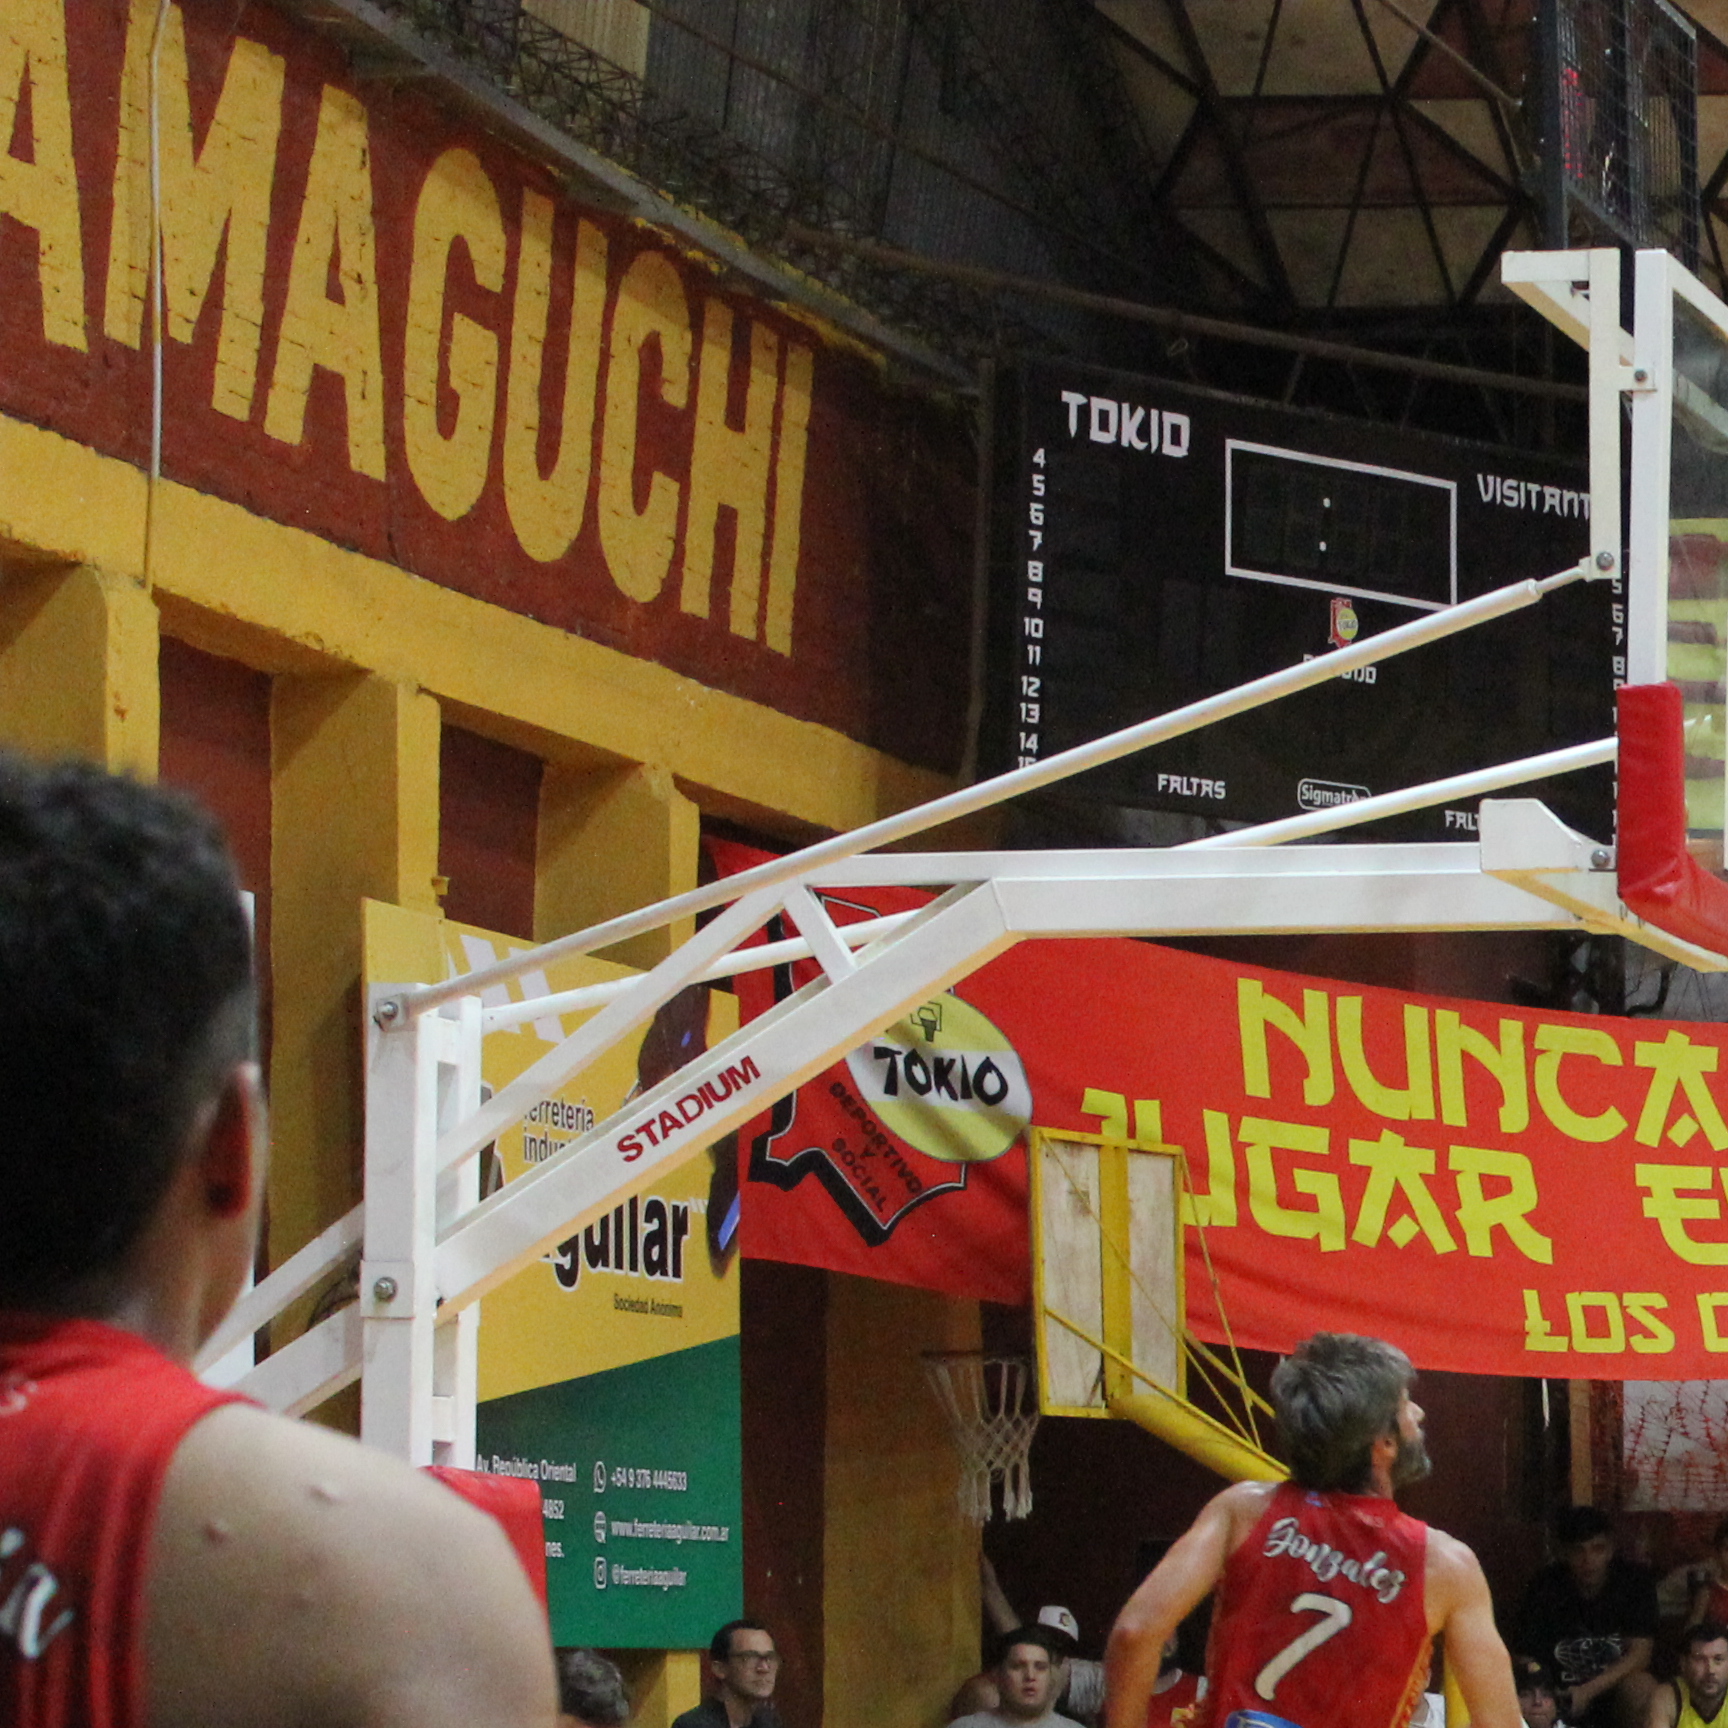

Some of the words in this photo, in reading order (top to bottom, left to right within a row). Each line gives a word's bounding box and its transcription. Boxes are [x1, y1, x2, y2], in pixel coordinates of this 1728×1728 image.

[1061, 390, 1190, 458] TOKIO
[1032, 447, 1046, 468] 4
[1032, 473, 1046, 496] 5
[1476, 473, 1591, 520] VISITANT
[1029, 502, 1044, 526] 6
[1028, 530, 1043, 551] 7
[1027, 560, 1044, 582] 8
[1027, 588, 1043, 610] 9
[1023, 616, 1044, 639] 10
[1027, 644, 1041, 666] 11
[1020, 675, 1041, 697] 12
[1019, 702, 1040, 724] 13
[1019, 731, 1039, 754] 14
[1157, 772, 1226, 800] FALTAS
[1445, 810, 1481, 832] FAL
[872, 1045, 1010, 1108] TOKIO
[523, 1097, 595, 1131] erretería
[617, 1054, 762, 1164] STADIUM
[829, 1081, 924, 1196] DEPORTIVO
[831, 1136, 888, 1214] SOCIAL
[538, 1195, 691, 1290] guilar
[1523, 1287, 1674, 1354] LOS
[540, 1460, 577, 1483] Oriental
[1254, 1592, 1353, 1702] 7
